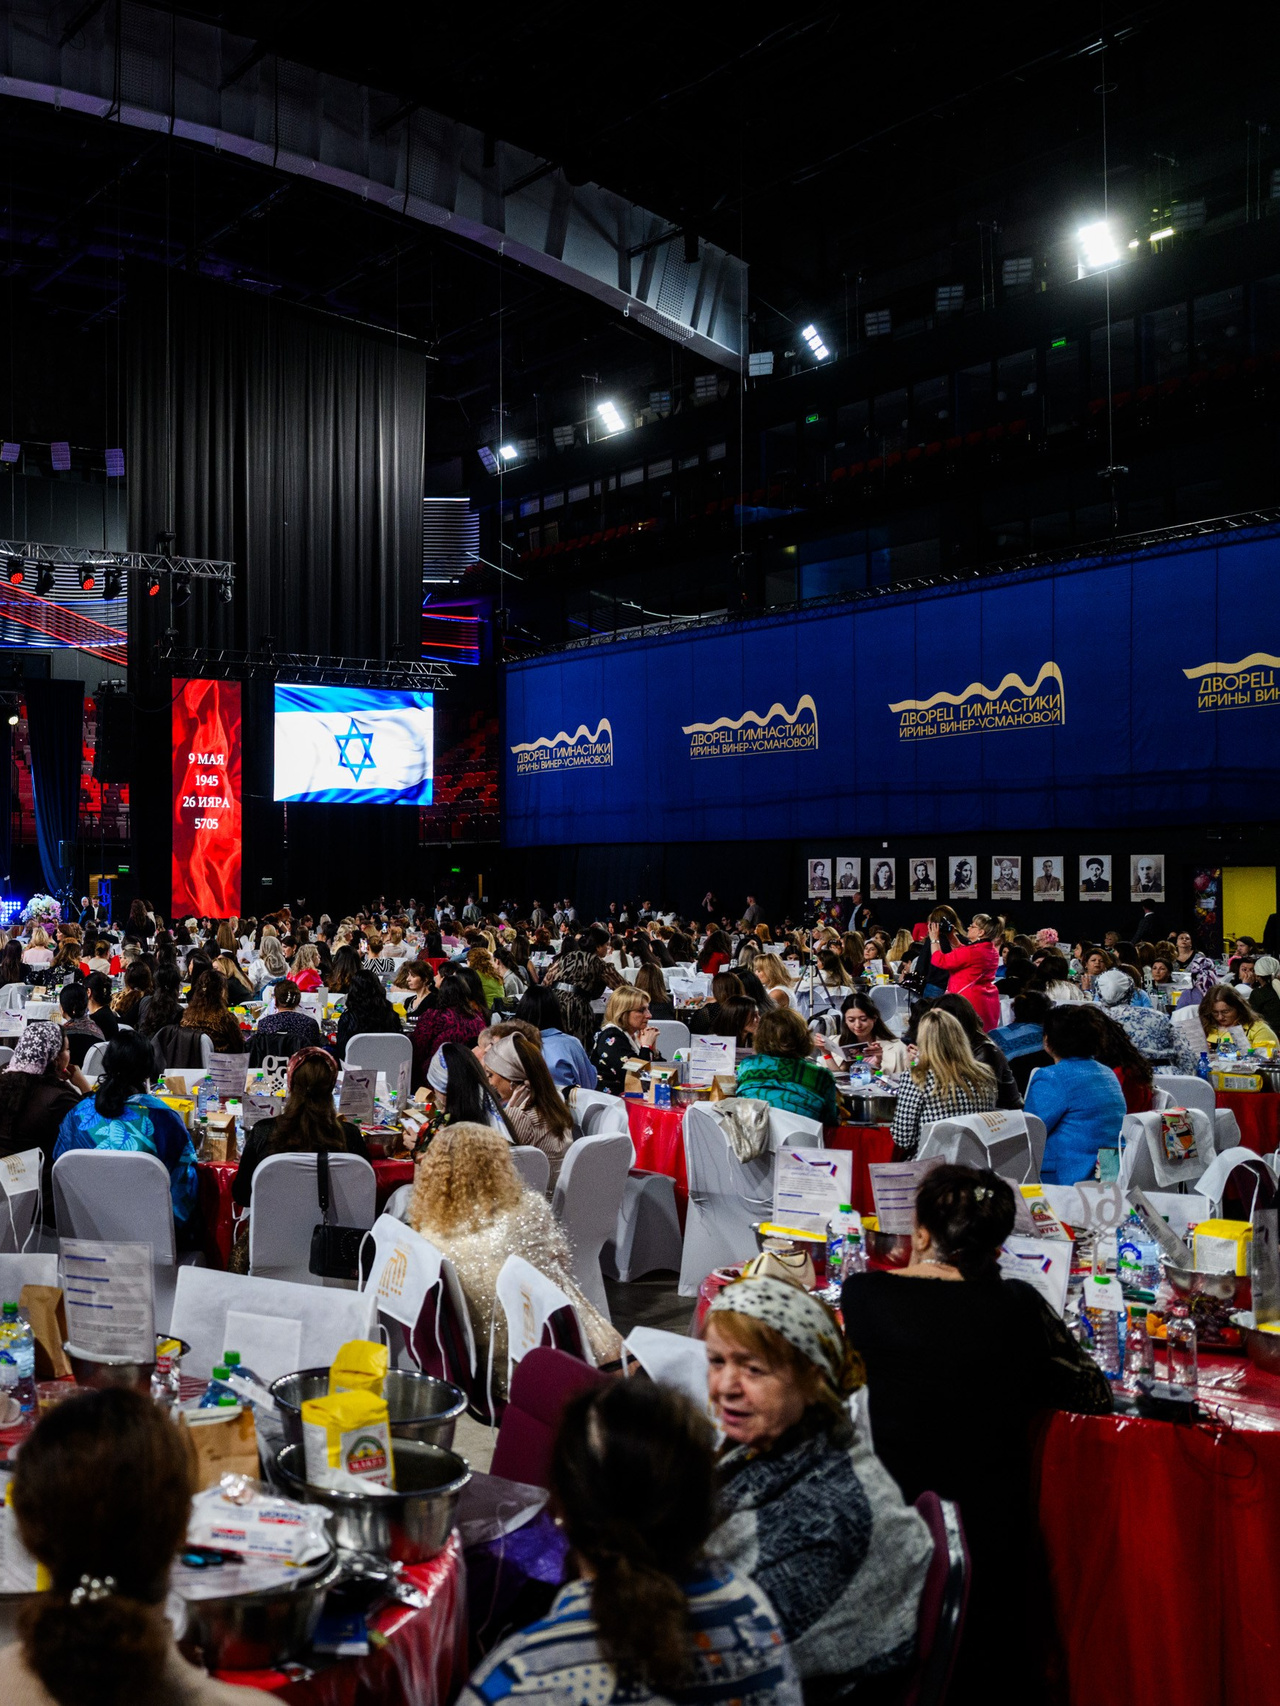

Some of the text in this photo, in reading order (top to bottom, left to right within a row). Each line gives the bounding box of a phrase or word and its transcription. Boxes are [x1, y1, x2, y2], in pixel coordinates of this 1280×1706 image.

[1198, 670, 1275, 694] ДВОРЕЦ
[900, 693, 1061, 726] ДВОРЕЦ ГИМНАСТИКИ
[1197, 690, 1251, 709] ИРИНЫ
[899, 708, 1061, 738] ИРИНЫ ВИНЕР-УСМАНОВОЙ
[690, 722, 815, 746] ДВОРЕЦ ГИМНАСТИКИ
[517, 742, 611, 763] ДВОРЕЦ ГИМНАСТИКИ
[690, 735, 815, 757] ИРИНЫ ВИНЕР-УСМАНОВОЙ
[188, 752, 225, 765] 9 МАЯ
[516, 753, 611, 773] ИРИНЫ ВИНЕР-УСМАНОВОЙ
[195, 774, 219, 787] 1945
[182, 796, 231, 809] 26 ИЯРА
[194, 817, 219, 830] 5705
